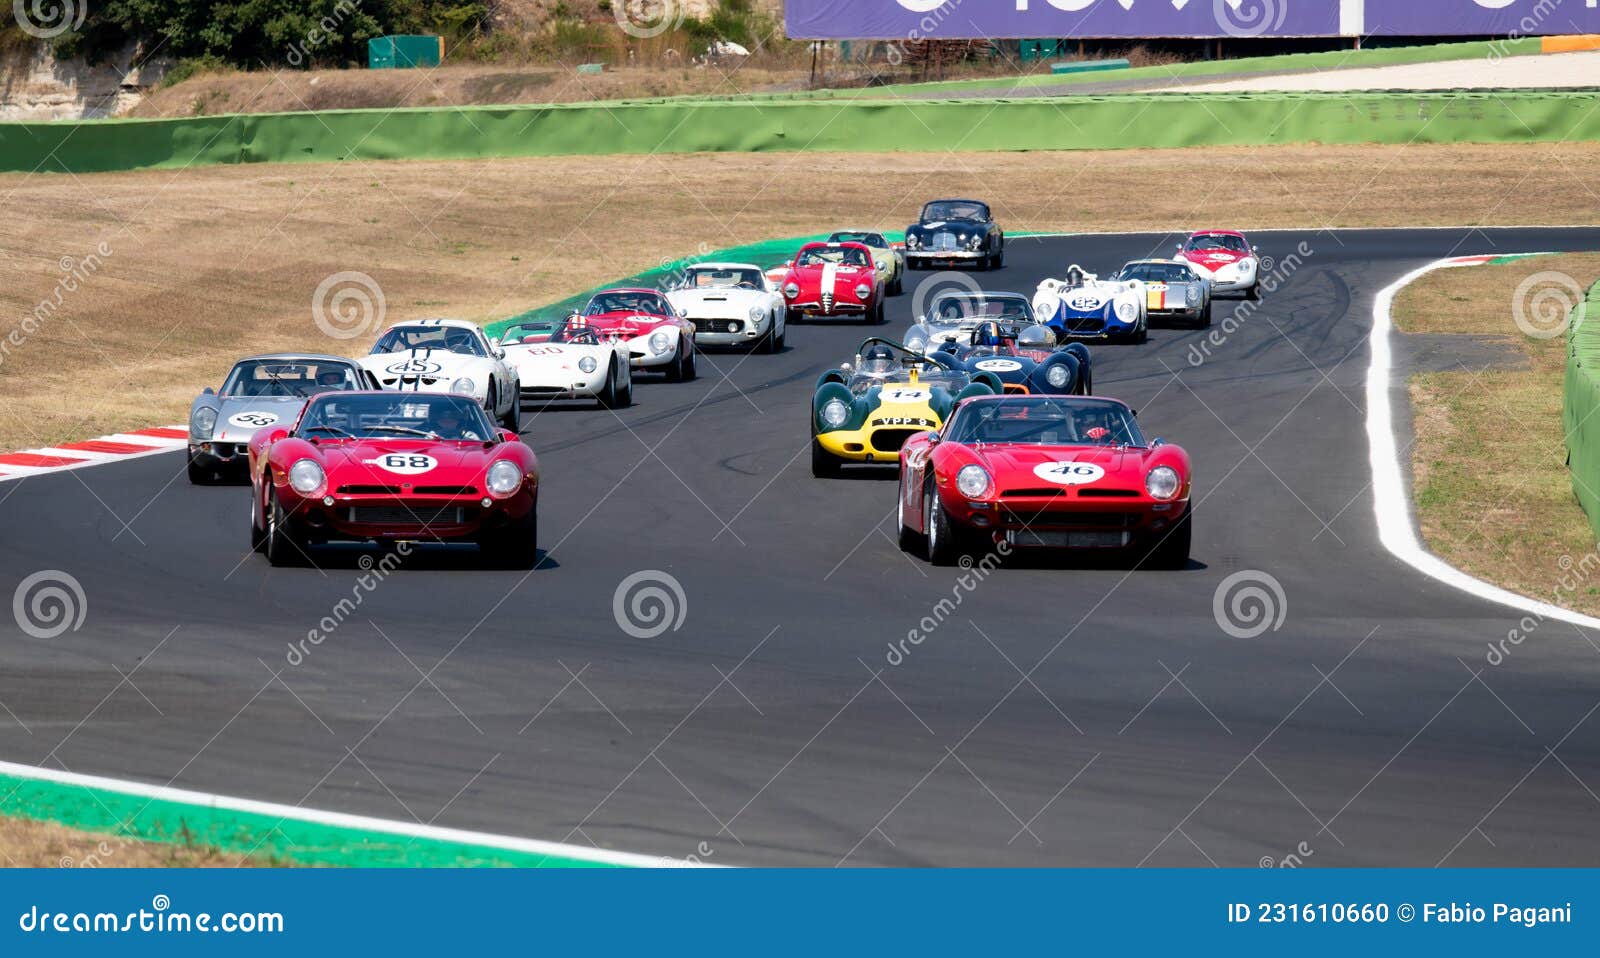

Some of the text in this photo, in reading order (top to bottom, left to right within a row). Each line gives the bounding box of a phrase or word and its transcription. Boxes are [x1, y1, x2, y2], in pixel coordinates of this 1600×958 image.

[1075, 297, 1099, 308] 92
[528, 347, 563, 355] 60
[395, 359, 428, 371] 45
[237, 414, 275, 426] 58
[882, 417, 927, 426] VPP 9
[386, 455, 429, 468] 68
[1050, 466, 1094, 475] 46
